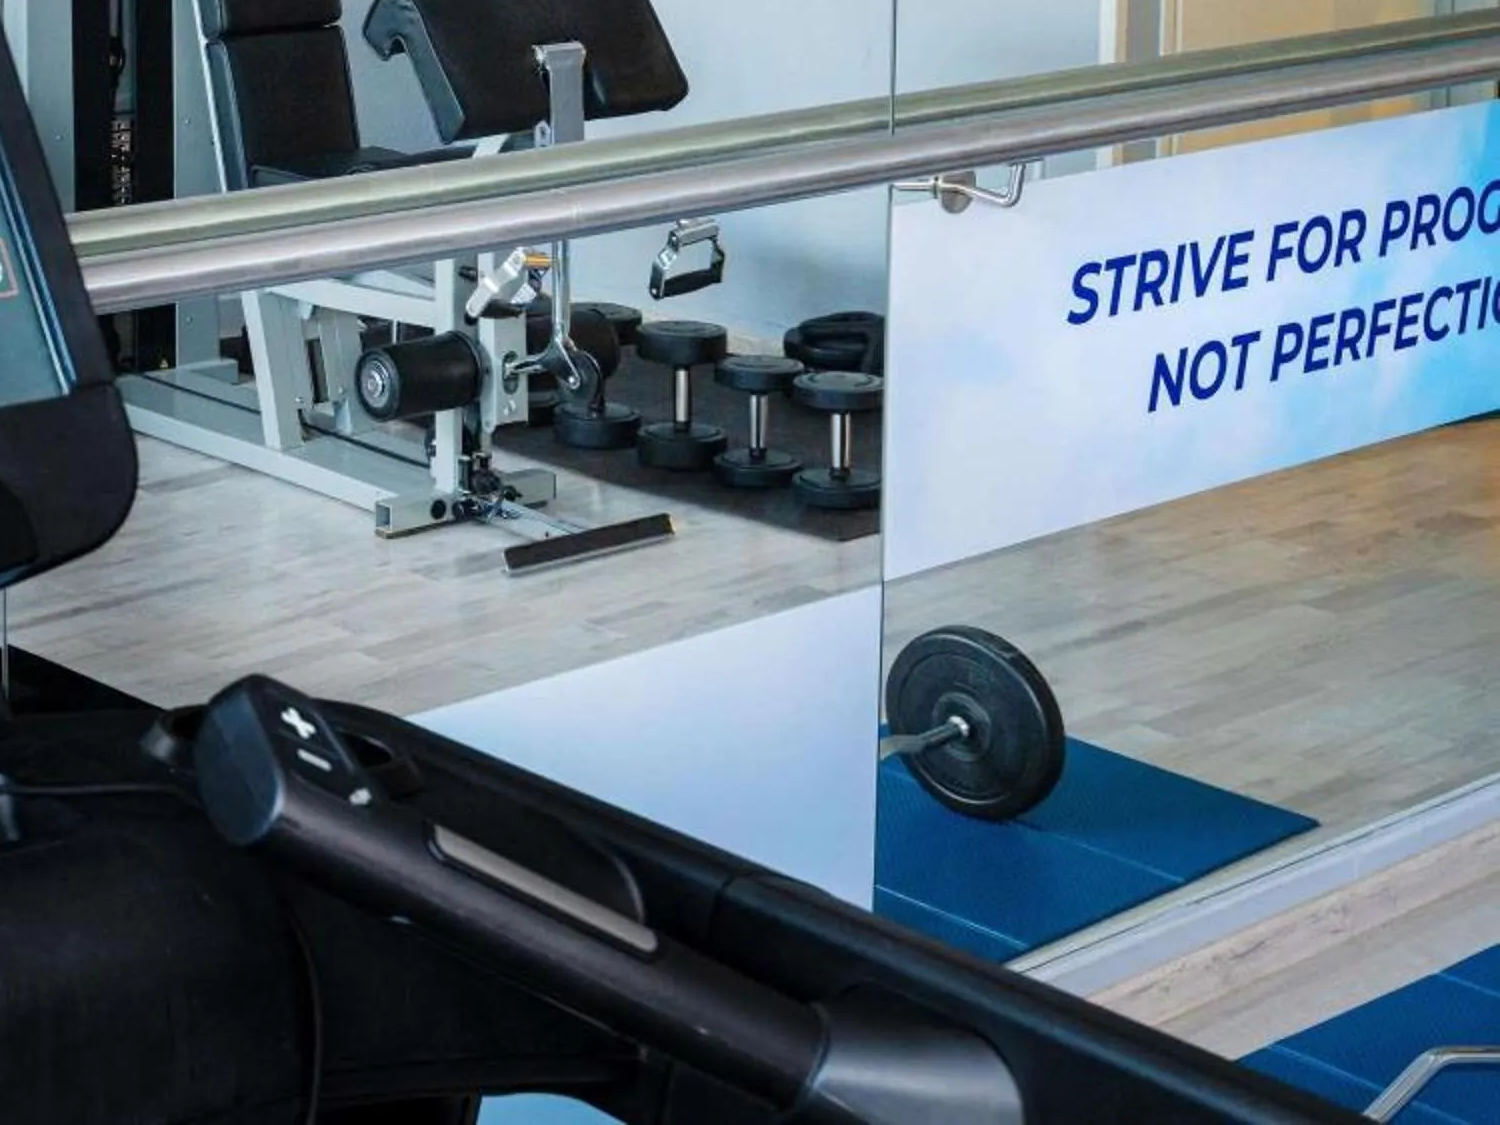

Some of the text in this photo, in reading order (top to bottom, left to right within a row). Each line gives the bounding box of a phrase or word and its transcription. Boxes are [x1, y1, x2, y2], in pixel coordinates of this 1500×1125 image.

[1067, 230, 1255, 325] STRIVE
[1266, 208, 1367, 282] FOR
[1148, 276, 1500, 413] NOT PERFECTI
